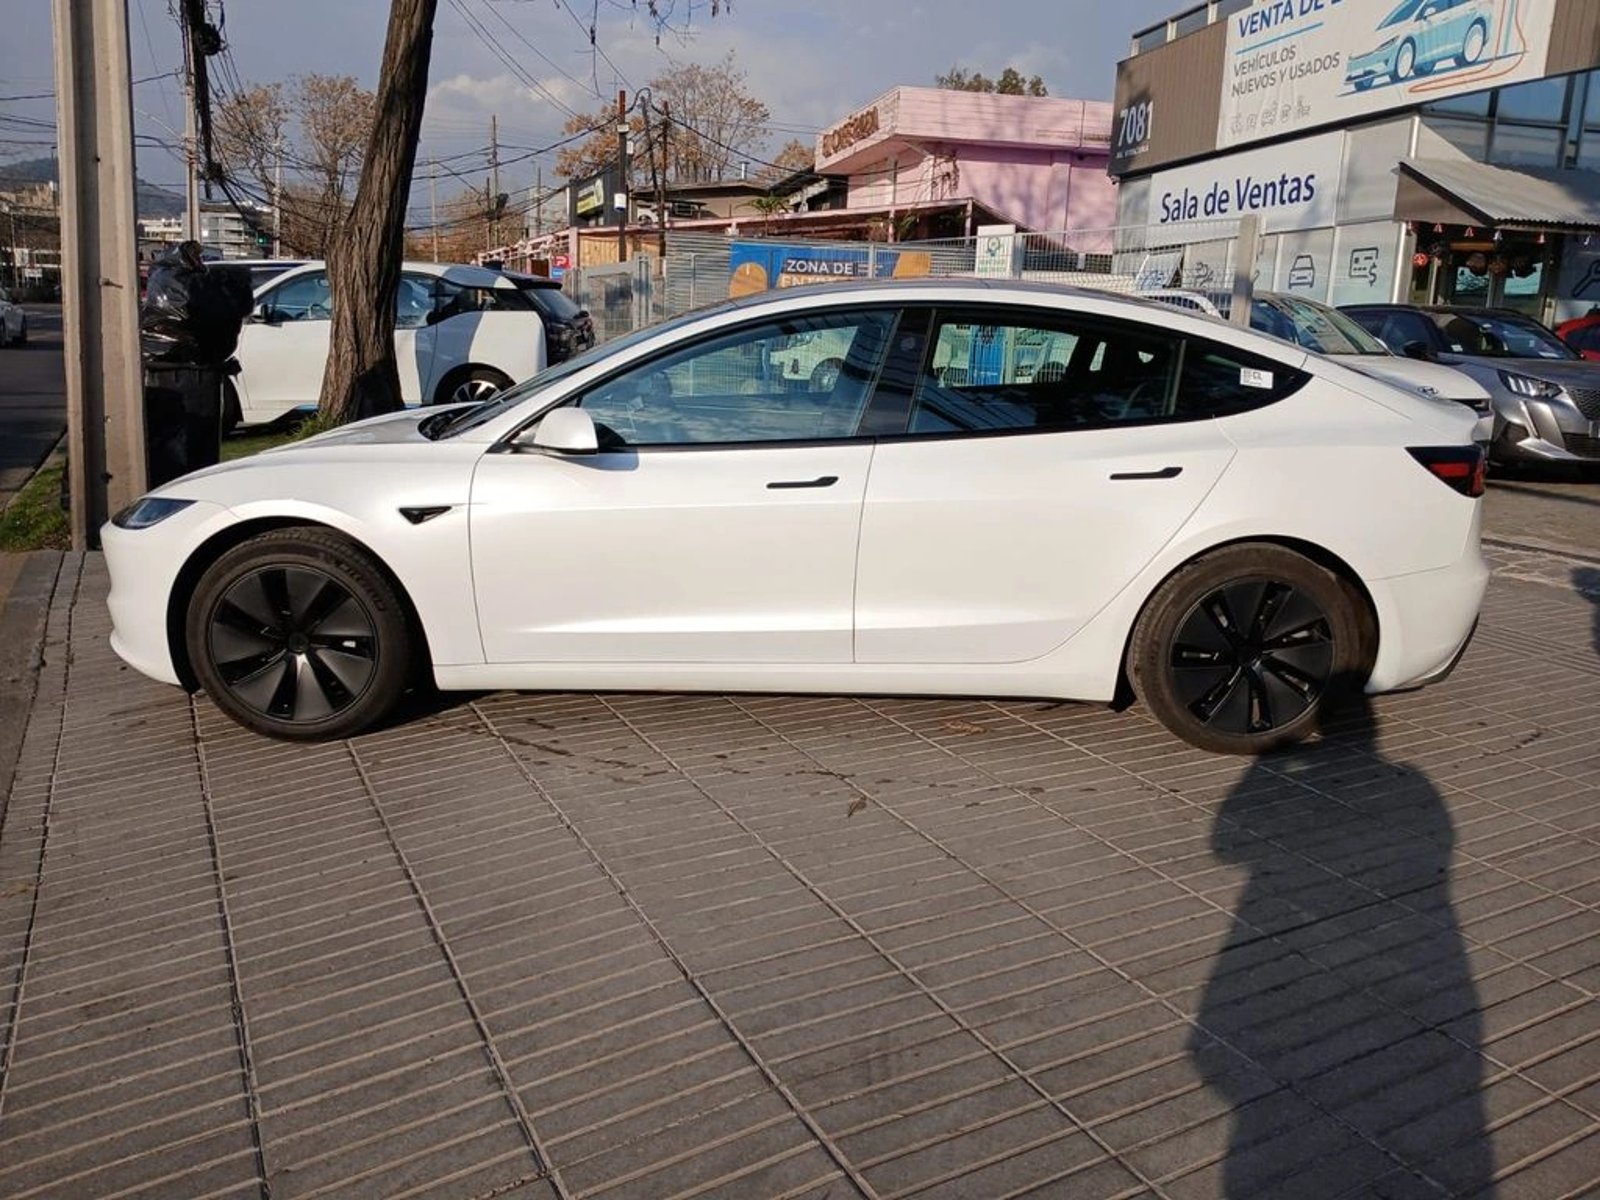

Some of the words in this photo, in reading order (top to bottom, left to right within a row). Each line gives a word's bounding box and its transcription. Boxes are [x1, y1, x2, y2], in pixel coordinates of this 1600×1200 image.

[1239, 0, 1294, 38] VENTA
[1231, 72, 1277, 97] NUEVOS
[1279, 66, 1288, 83] Y
[1289, 52, 1340, 80] USADOS
[1234, 45, 1297, 77] VEHÍCULOS
[1118, 100, 1153, 147] 7081
[1160, 187, 1198, 223] Sala
[1204, 181, 1230, 216] de
[1236, 173, 1315, 211] Ventas
[787, 260, 829, 273] ZONA
[833, 261, 854, 274] DE
